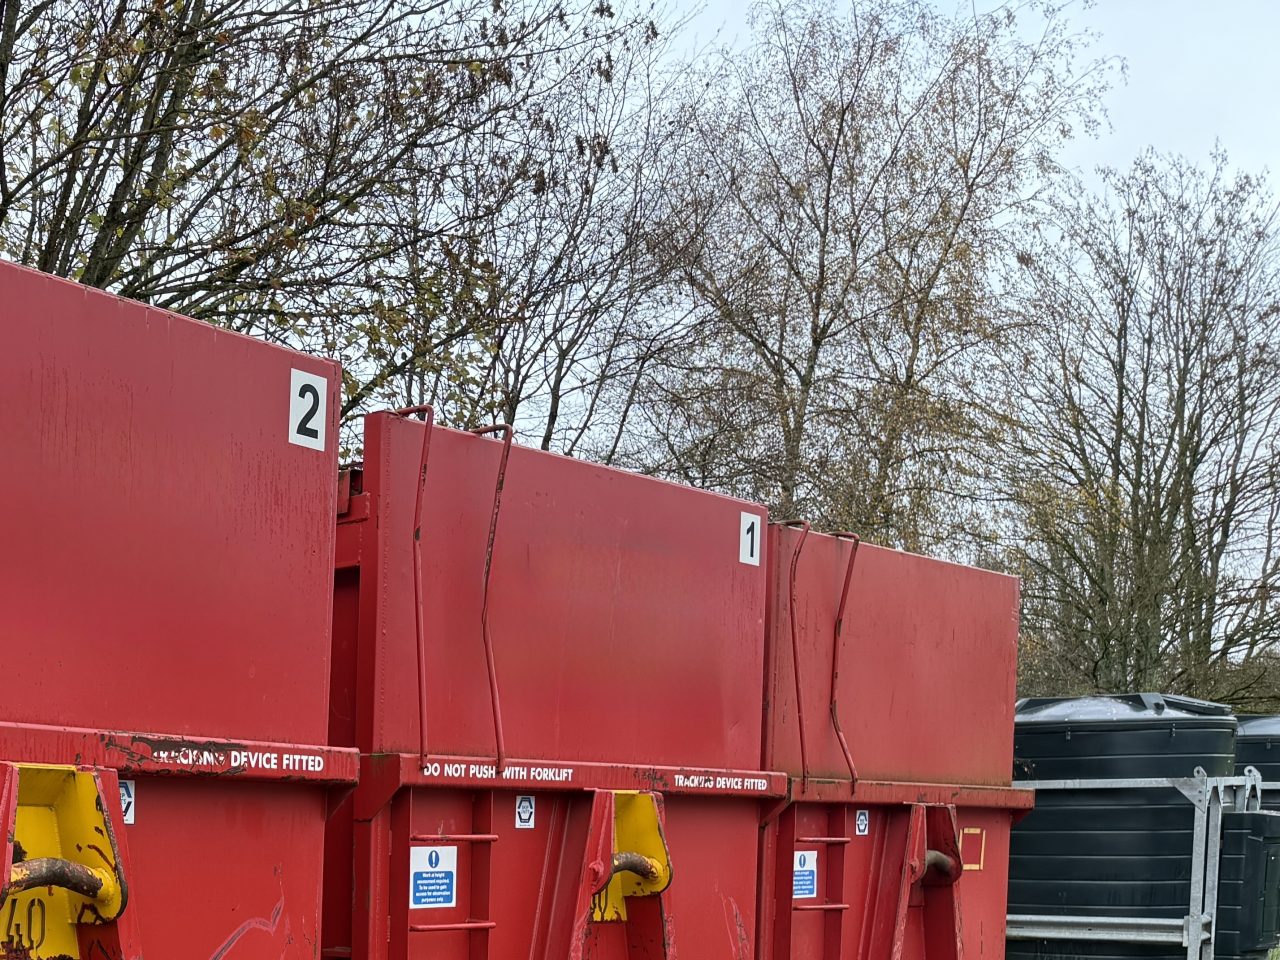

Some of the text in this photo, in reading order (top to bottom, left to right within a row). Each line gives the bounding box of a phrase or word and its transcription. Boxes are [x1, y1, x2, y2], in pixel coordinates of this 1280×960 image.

[296, 383, 320, 440] 2
[746, 521, 755, 558] 1
[230, 750, 278, 769] DEVICE
[282, 754, 325, 772] FITTED
[423, 762, 574, 782] DO NOT PUSH WITH FORKLIFT
[716, 776, 742, 790] DEVICE
[743, 778, 768, 791] FITTED
